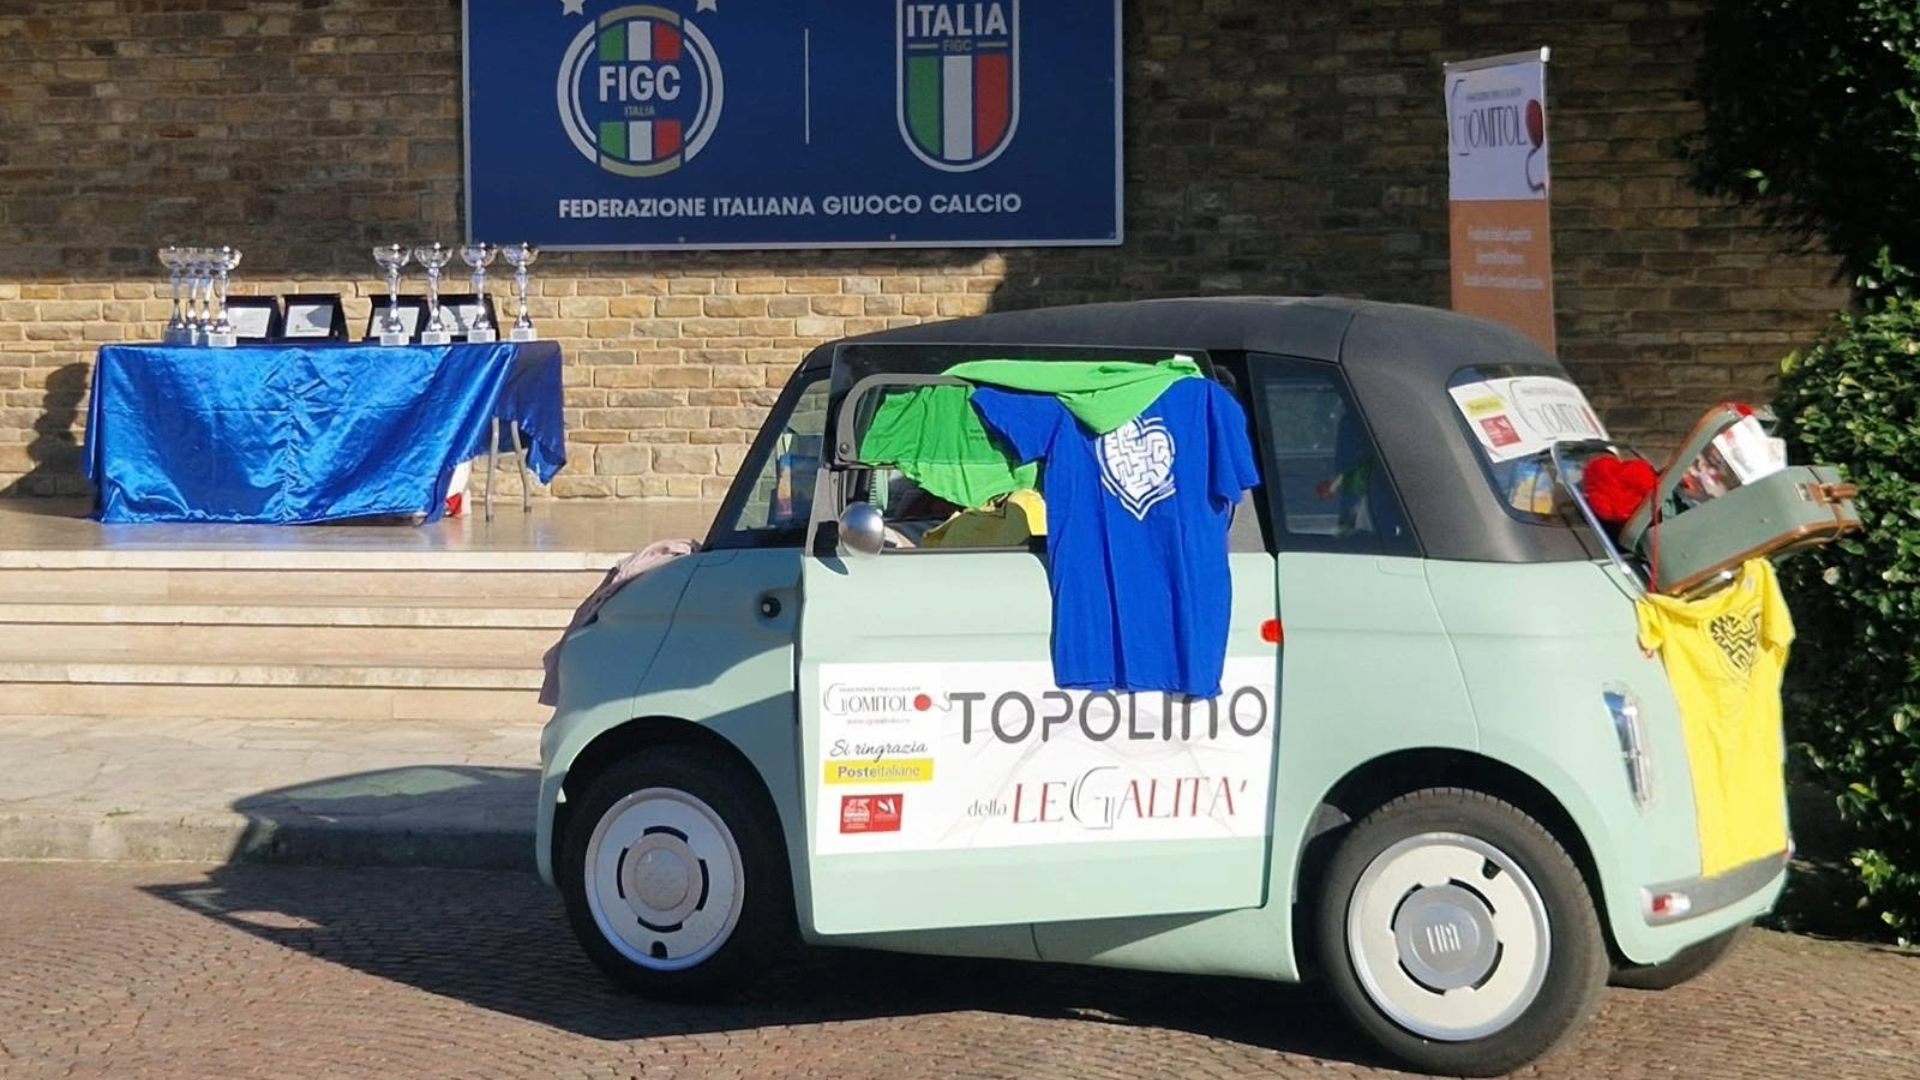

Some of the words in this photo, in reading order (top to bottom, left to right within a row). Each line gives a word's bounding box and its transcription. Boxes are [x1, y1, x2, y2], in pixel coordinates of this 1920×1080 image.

[906, 2, 1008, 37] ITALIA
[943, 39, 972, 52] FIGC
[600, 65, 681, 102] FIGC
[624, 105, 656, 117] ITALIA
[559, 199, 706, 218] FEDERAZIONE
[713, 197, 815, 216] ITALIANA
[823, 195, 922, 215] GIUOCO
[930, 193, 1022, 213] CALCIO
[830, 739, 849, 757] Si
[855, 742, 928, 763] ringrazia
[967, 799, 1007, 817] della
